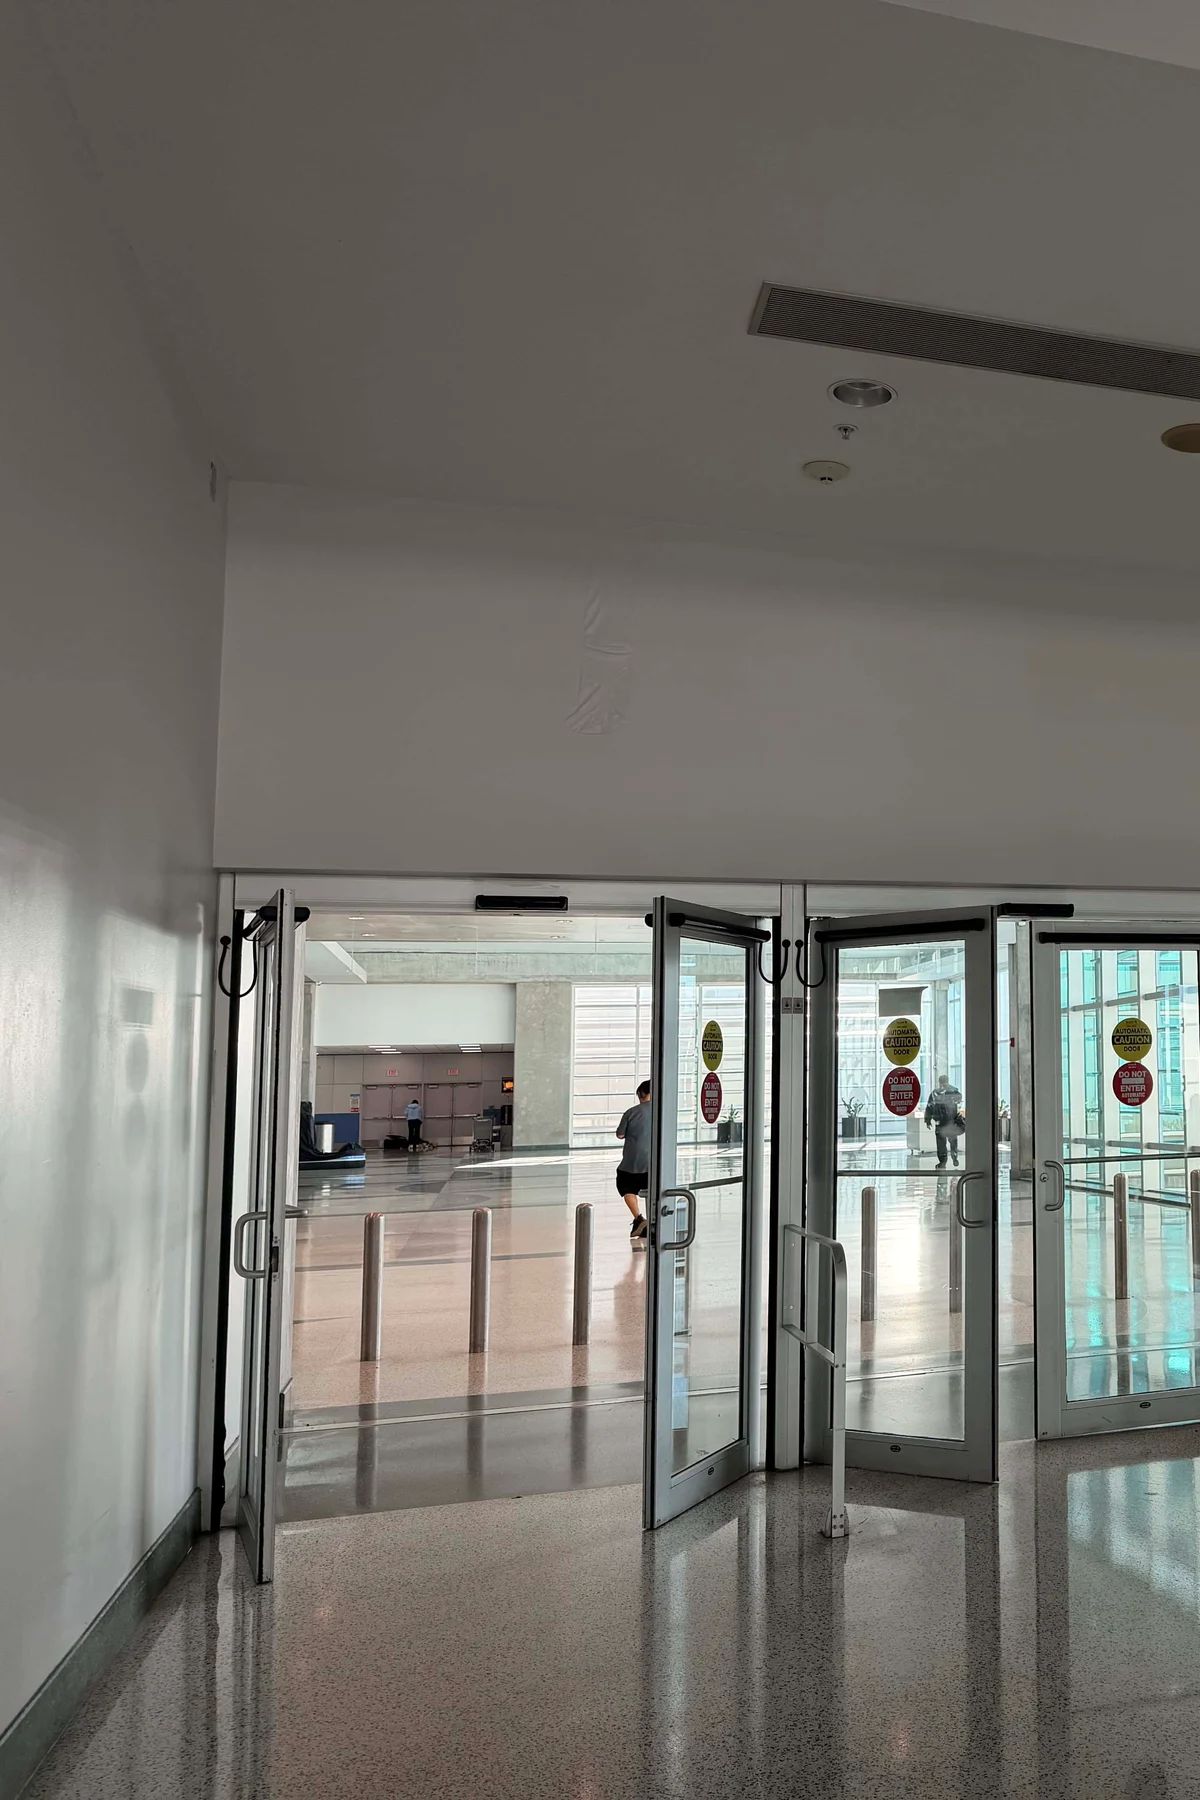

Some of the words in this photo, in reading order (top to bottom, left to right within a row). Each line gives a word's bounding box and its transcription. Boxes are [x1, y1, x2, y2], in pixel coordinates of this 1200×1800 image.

[887, 1028, 917, 1036] AUTOMATIC
[885, 1037, 919, 1047] CAUTION
[1113, 1035, 1150, 1044] CAUTION
[703, 1041, 723, 1050] CAUTION
[888, 1076, 899, 1085] DO
[900, 1076, 915, 1084] NOT
[704, 1082, 711, 1090] DO
[711, 1082, 720, 1090] NOT
[1120, 1084, 1146, 1092] ENTER
[889, 1091, 914, 1100] ENTER
[704, 1098, 719, 1107] ENTER
